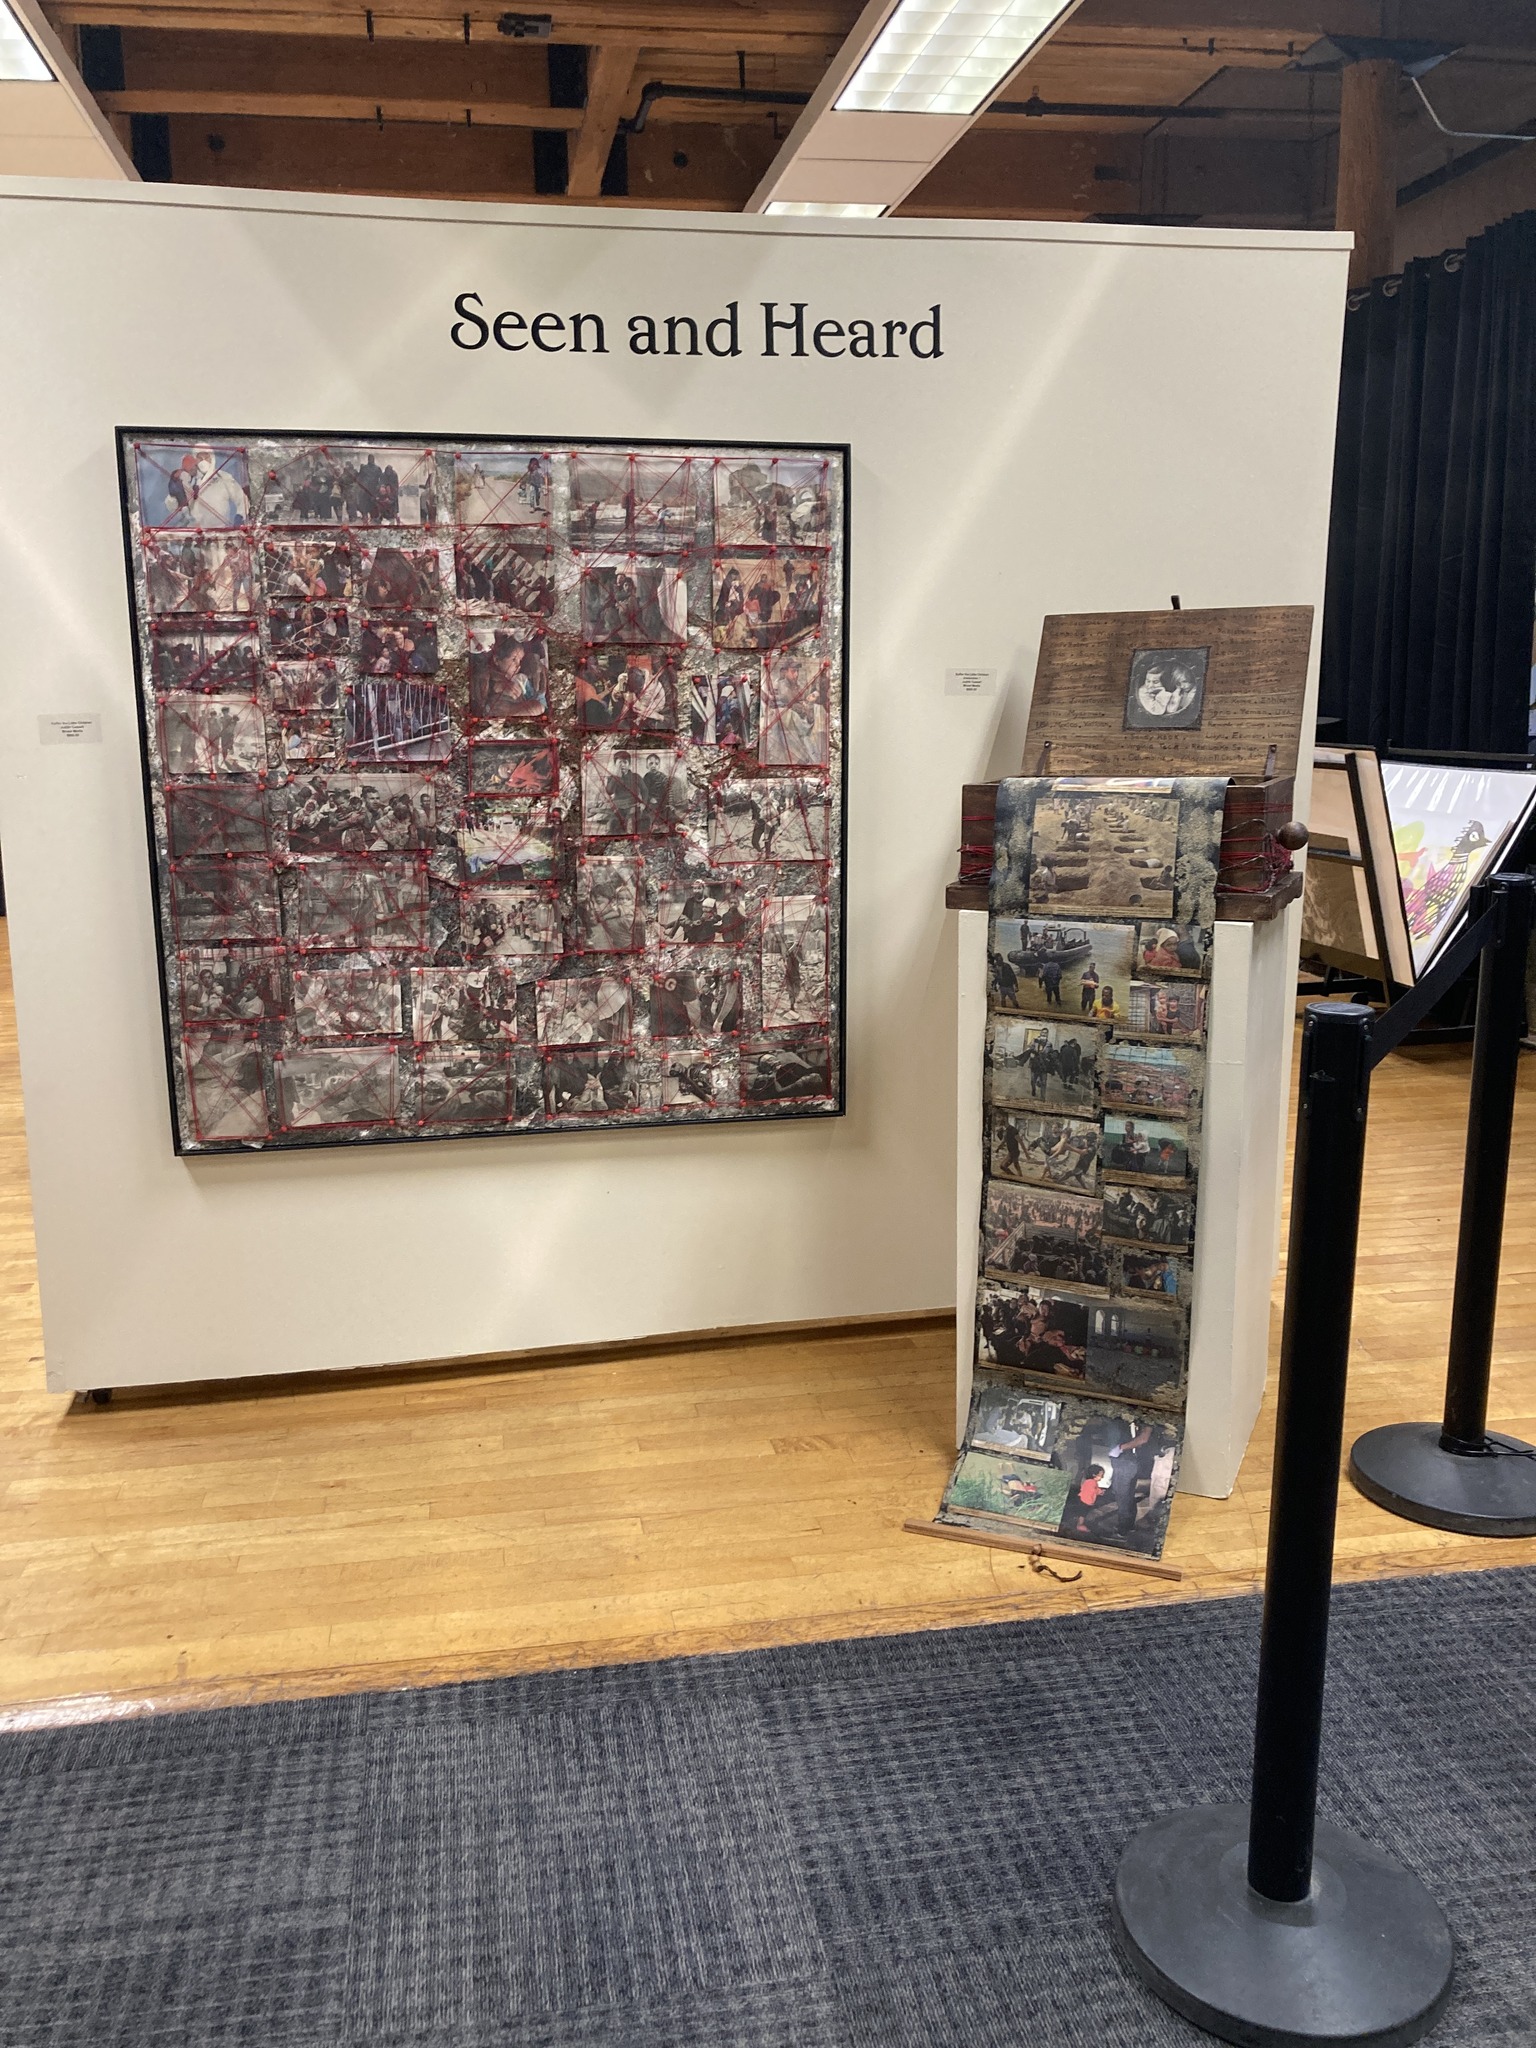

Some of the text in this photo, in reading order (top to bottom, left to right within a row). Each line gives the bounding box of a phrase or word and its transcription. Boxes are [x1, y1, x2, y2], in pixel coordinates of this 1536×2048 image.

[450, 292, 944, 359] Seen and Heard
